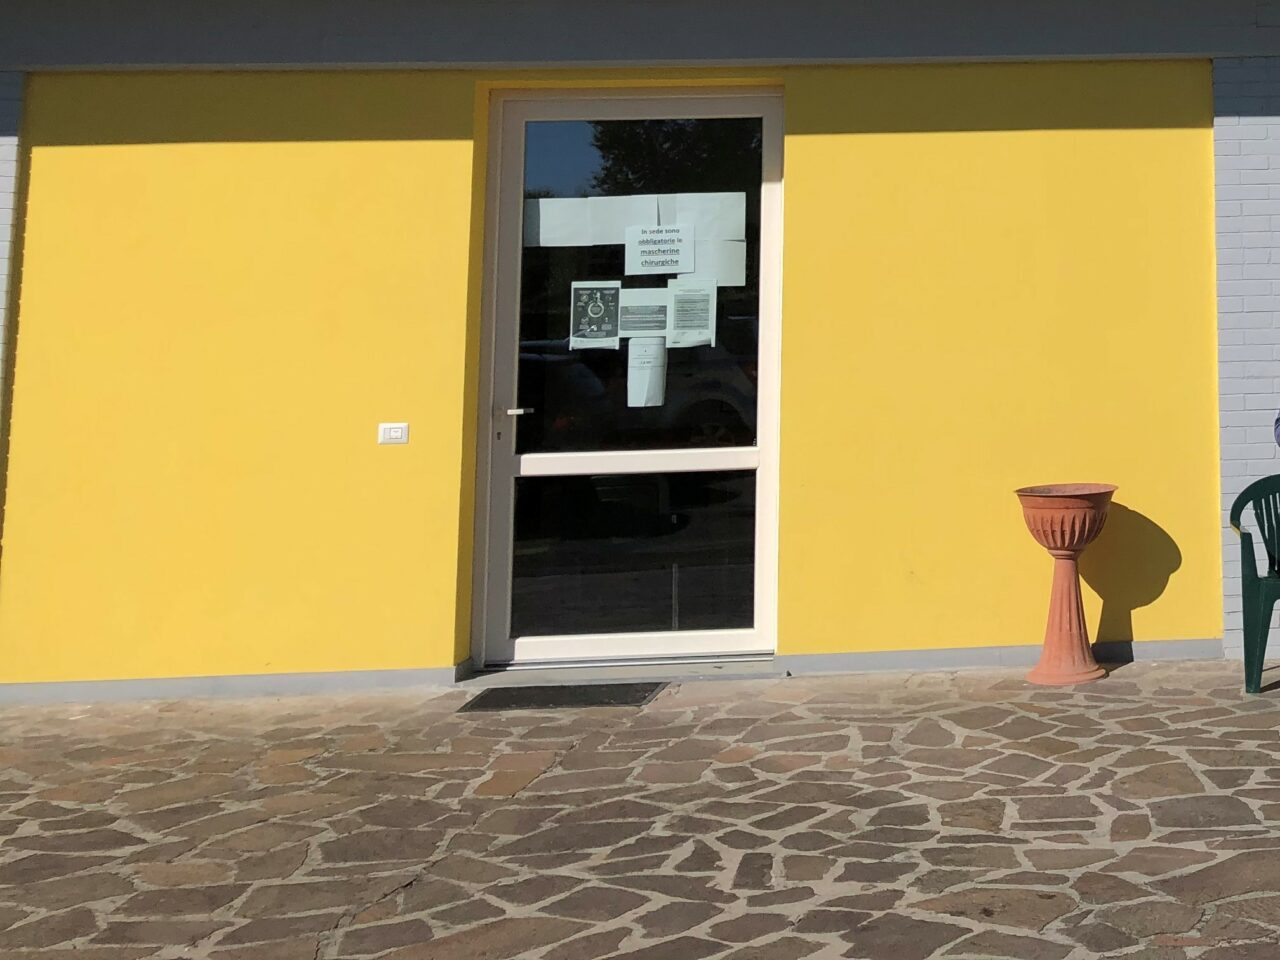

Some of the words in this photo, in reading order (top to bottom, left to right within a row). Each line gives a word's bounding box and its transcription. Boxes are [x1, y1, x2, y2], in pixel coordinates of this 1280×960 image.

[638, 237, 675, 245] obbligatorie
[640, 248, 680, 256] mascherine
[641, 258, 679, 267] chirurgiche
